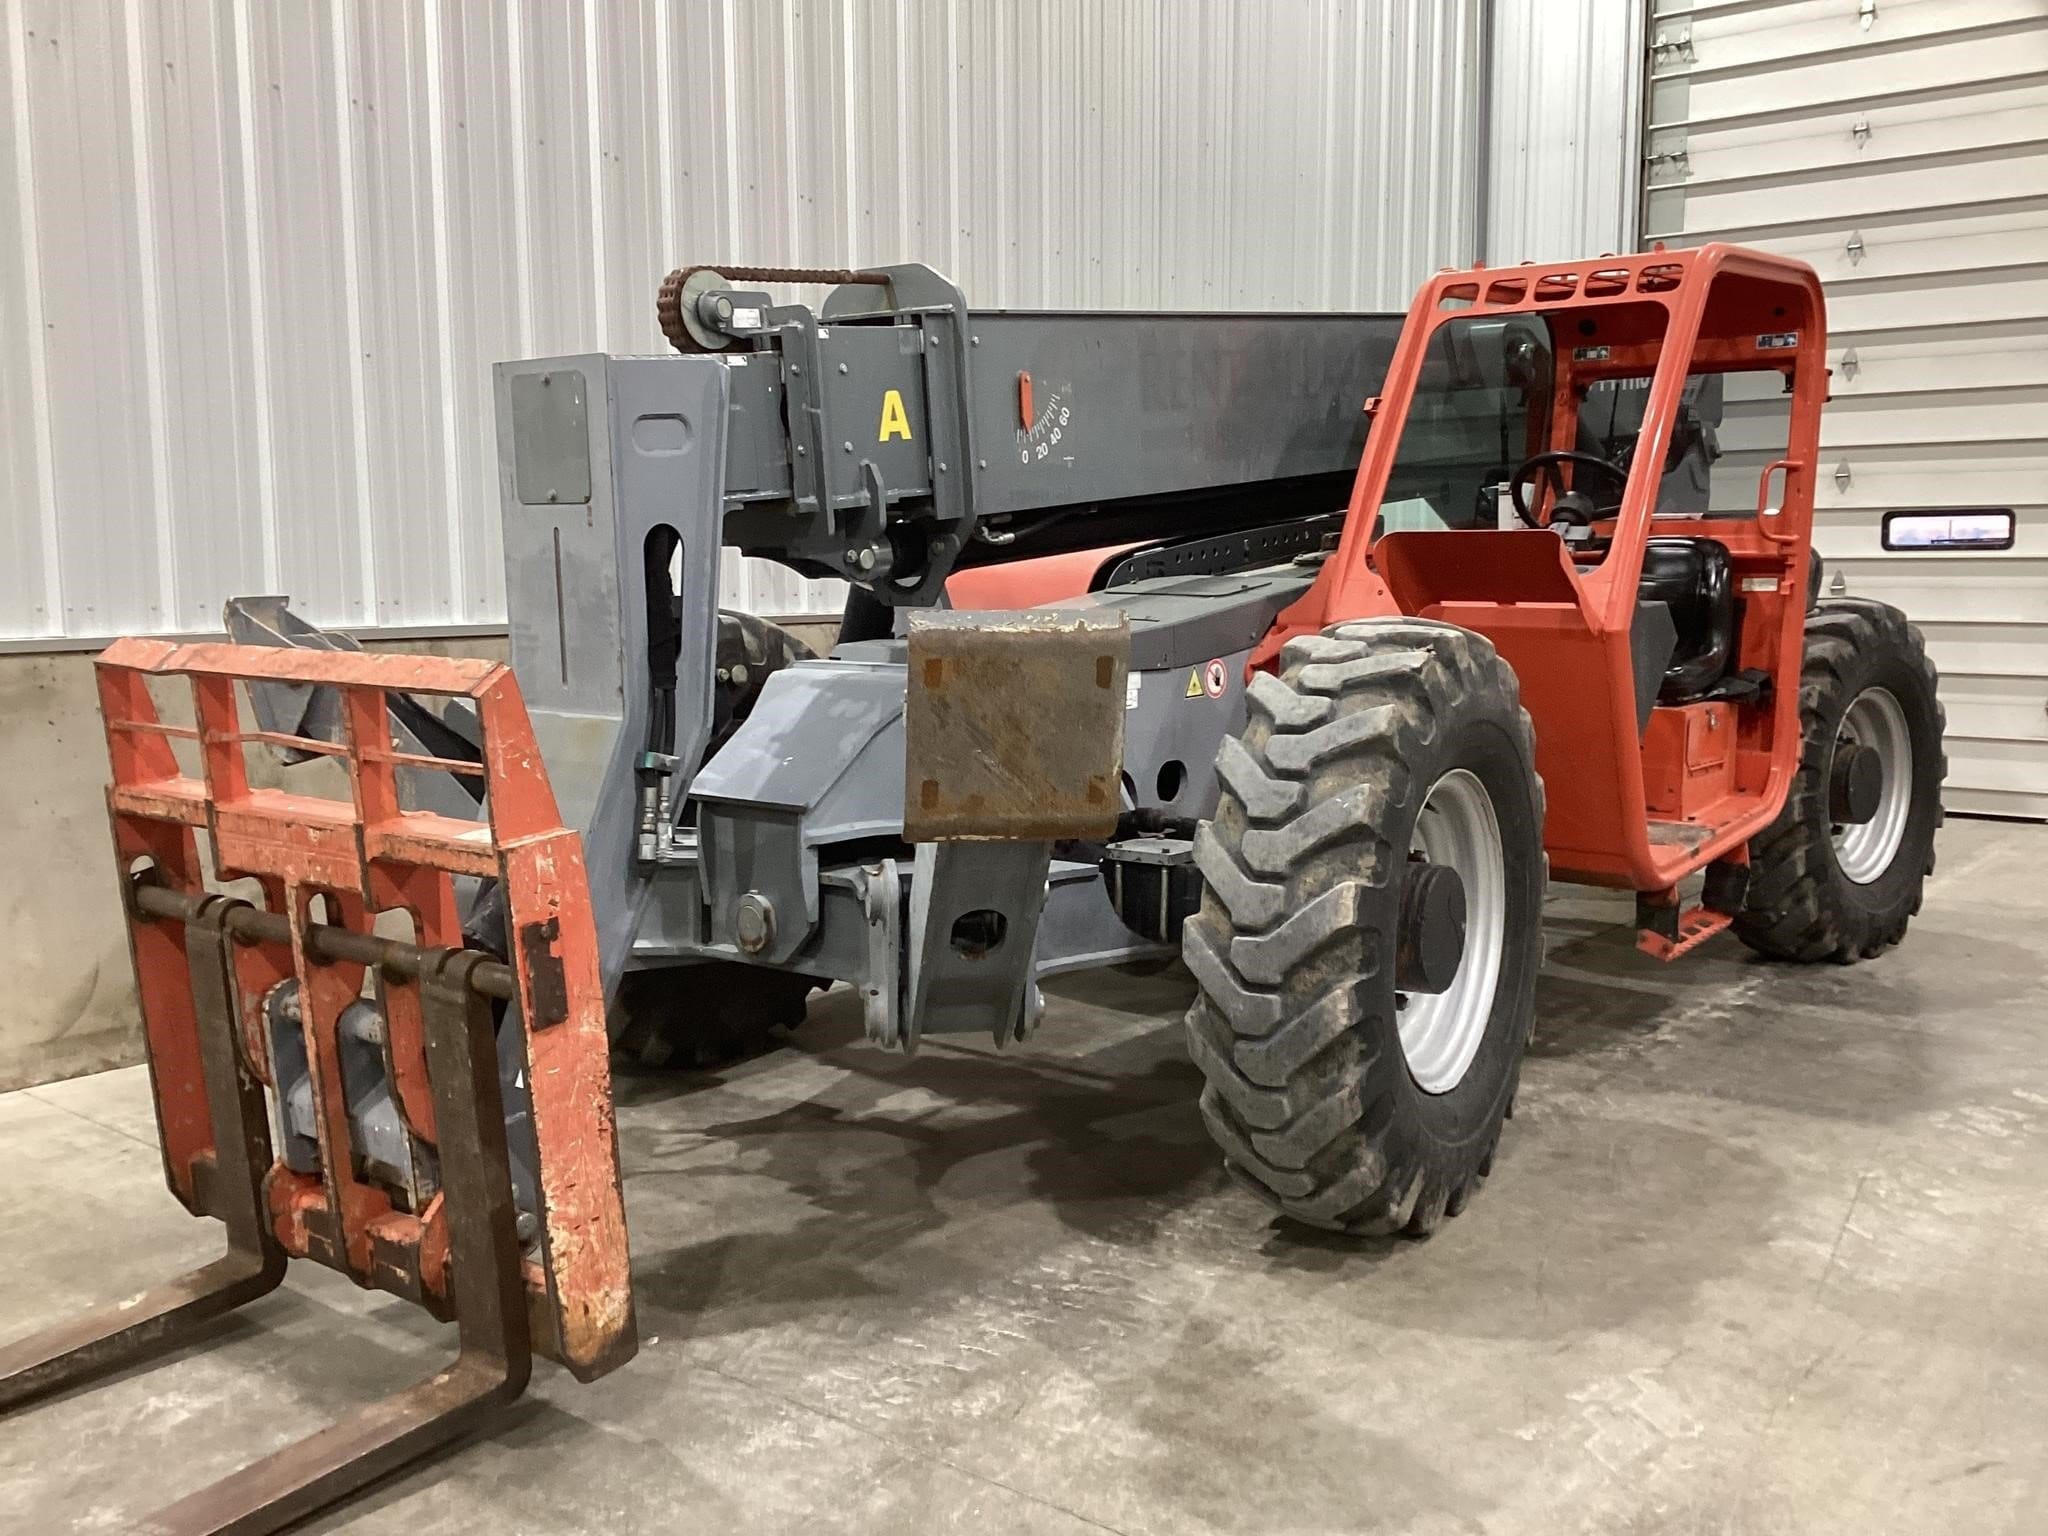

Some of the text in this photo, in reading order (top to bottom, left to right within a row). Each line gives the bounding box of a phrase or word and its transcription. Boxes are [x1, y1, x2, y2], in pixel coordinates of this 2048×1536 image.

[878, 389, 913, 442] A
[1021, 450, 1029, 464] 0
[1035, 442, 1049, 460] 20
[1049, 427, 1062, 445] 40
[1058, 406, 1070, 426] 60
